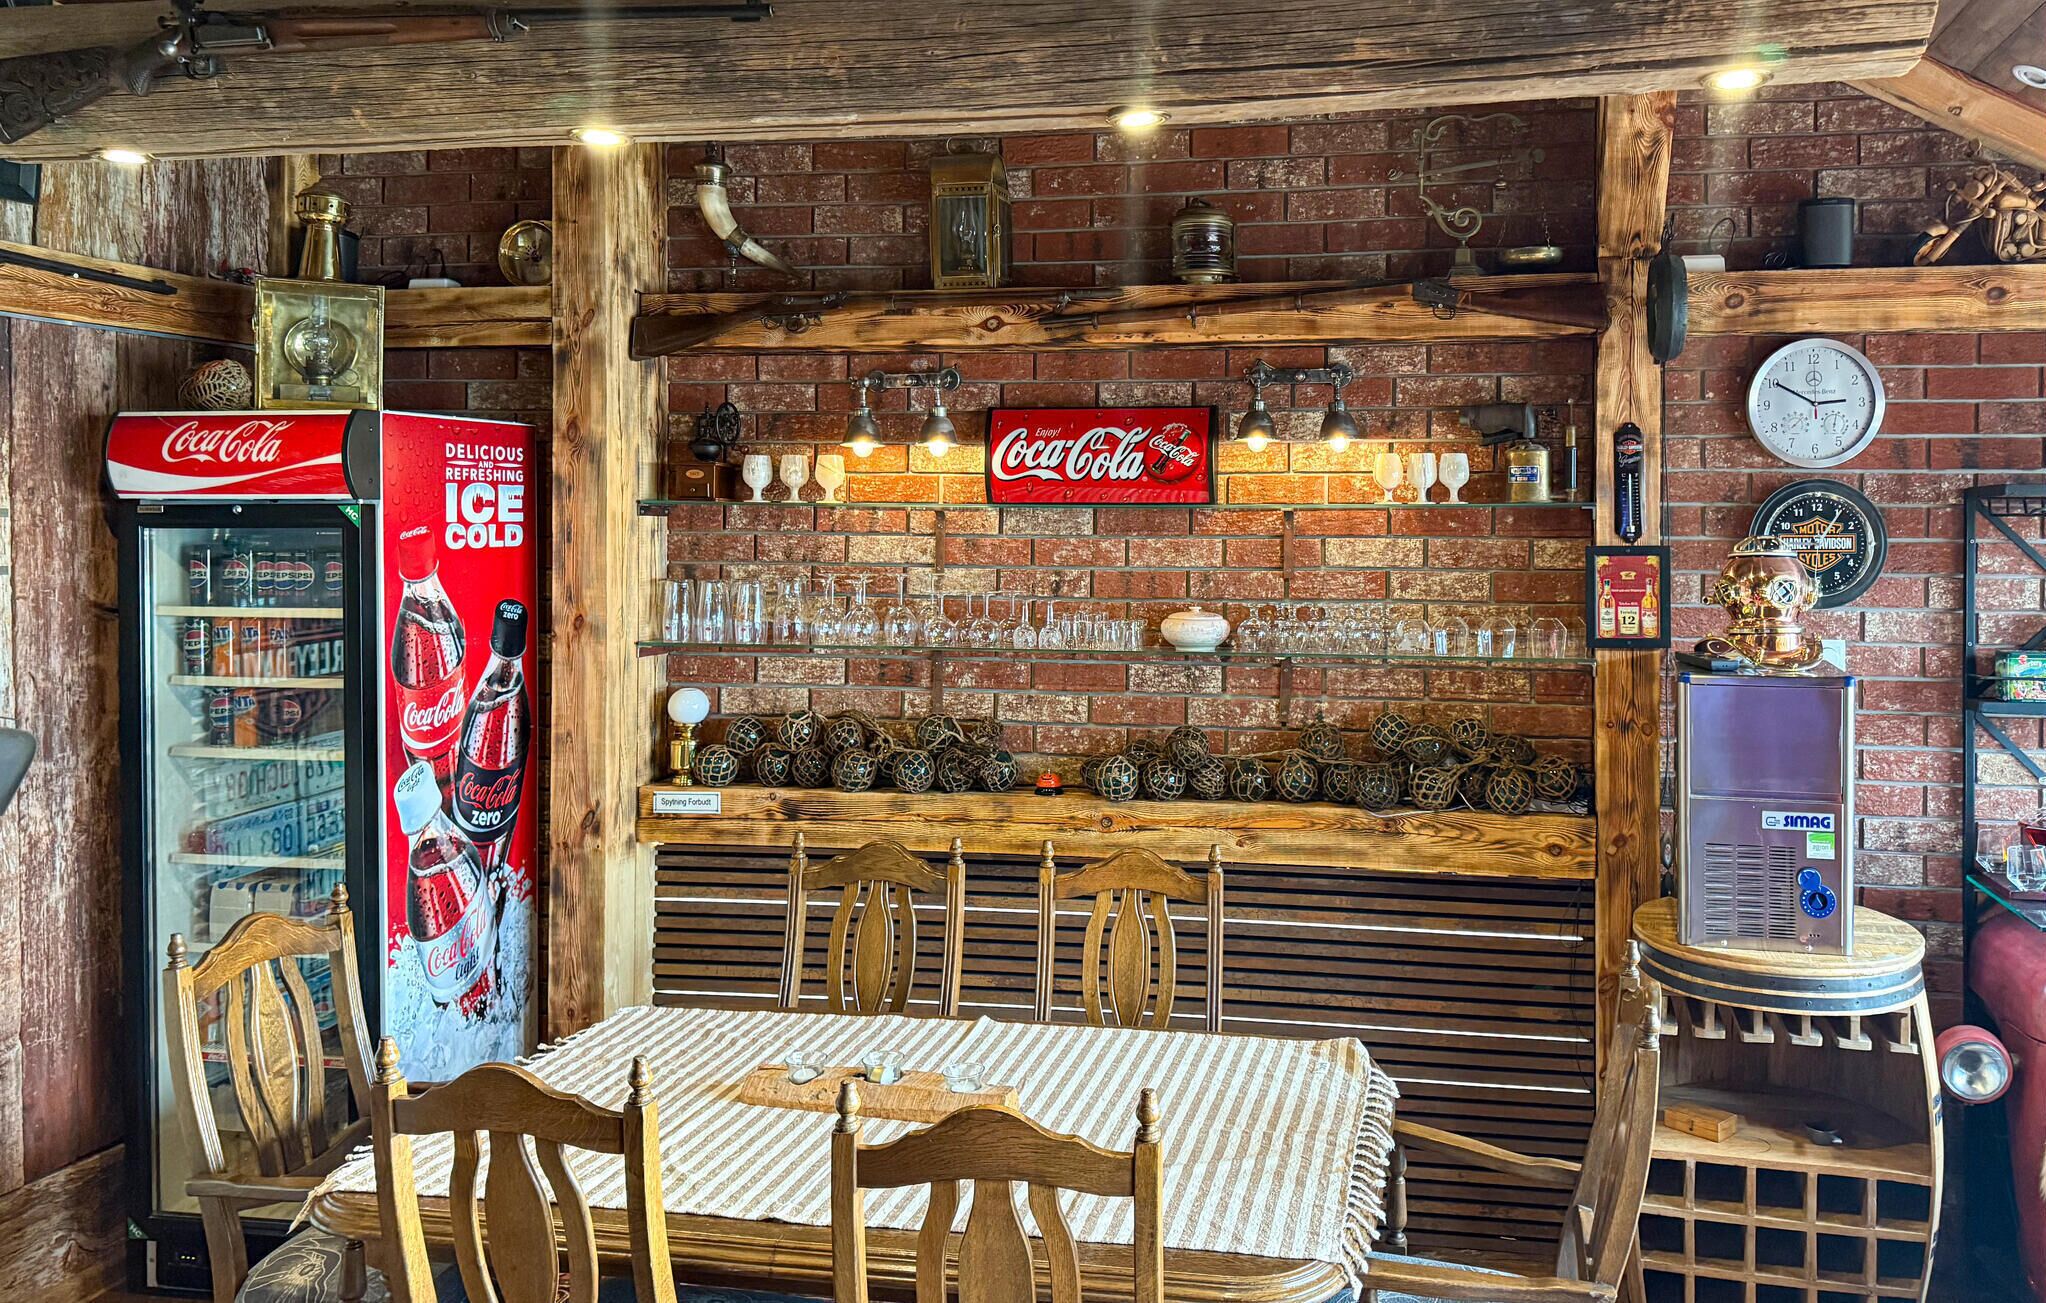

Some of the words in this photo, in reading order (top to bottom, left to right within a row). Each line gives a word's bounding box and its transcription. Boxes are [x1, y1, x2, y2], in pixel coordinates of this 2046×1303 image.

[1808, 354, 1820, 365] 12
[1835, 360, 1839, 370] 1
[1785, 361, 1795, 372] 11
[1851, 375, 1858, 385] 2
[1763, 400, 1771, 410] 9
[1858, 397, 1866, 407] 3
[1771, 423, 1778, 432] 8
[1852, 419, 1859, 430] 4
[1035, 427, 1061, 438] Enjoy!
[162, 420, 296, 463] Coca-Cola
[1788, 438, 1795, 448] 7
[1835, 436, 1842, 447] 5
[445, 443, 524, 462] DELICIOUS
[992, 426, 1152, 482] Coca-Cola
[1812, 443, 1819, 454] 6
[478, 460, 494, 469] AND
[445, 468, 524, 483] REFRESHING
[445, 482, 525, 524] ICE
[1812, 503, 1823, 511] 12
[345, 506, 359, 521] HC
[1781, 522, 1790, 530] 10
[1799, 521, 1838, 534] MOTOR
[1848, 522, 1855, 530] 2
[445, 523, 524, 550] COLD
[1799, 553, 1836, 567] CYCLES
[1847, 559, 1854, 567] 4
[503, 612, 519, 620] zero
[1622, 616, 1636, 625] 12
[459, 769, 521, 810] Coca-Cola
[661, 797, 687, 807] Spytning
[688, 797, 712, 806] Forbudt
[471, 809, 502, 826] zero
[1783, 815, 1831, 829] SIMAG
